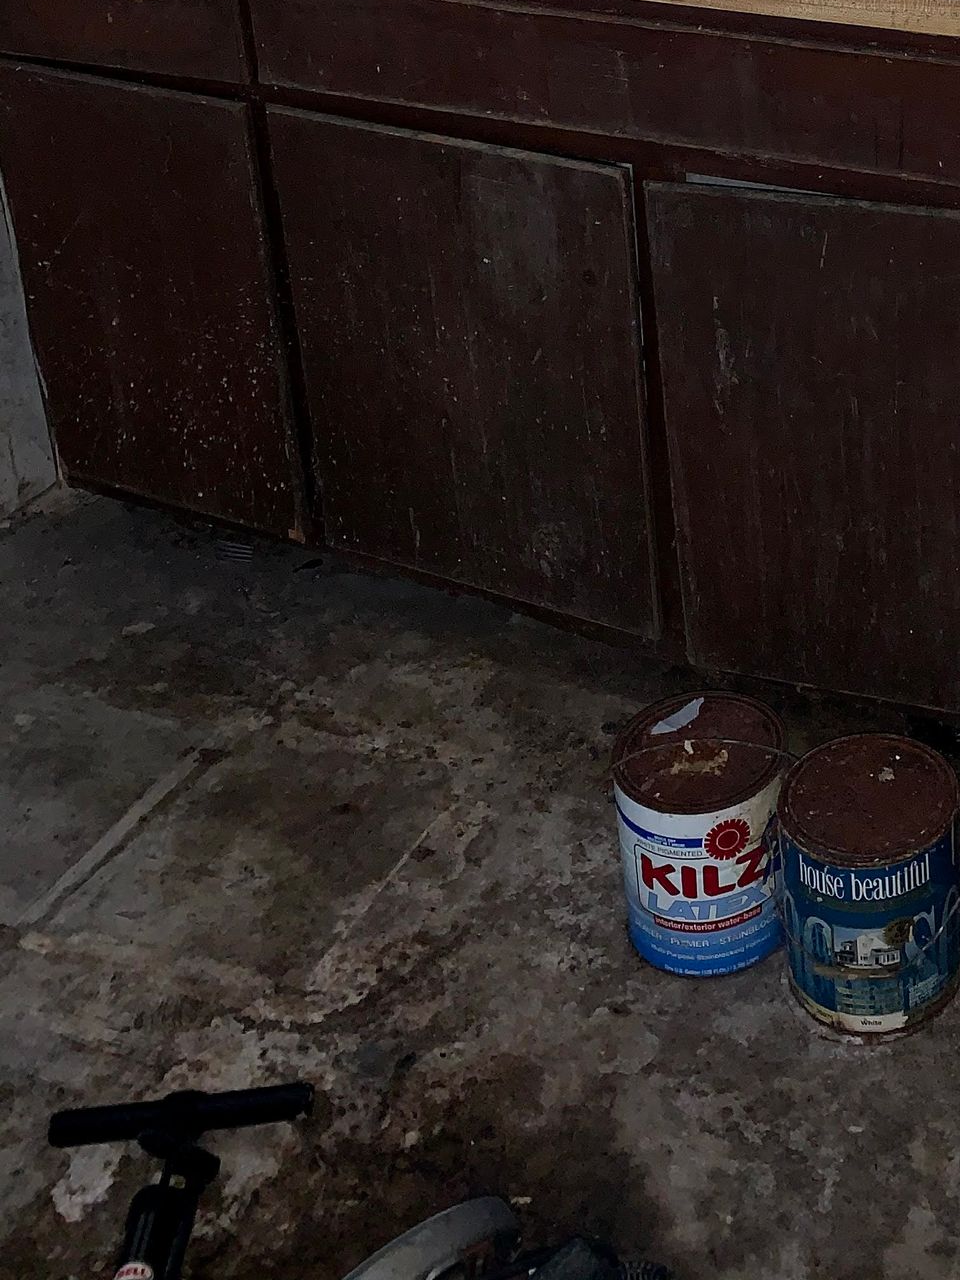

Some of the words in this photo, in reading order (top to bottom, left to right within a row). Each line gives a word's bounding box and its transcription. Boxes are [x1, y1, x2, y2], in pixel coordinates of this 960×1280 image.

[640, 846, 767, 899] KILZ
[798, 853, 846, 900] house
[849, 852, 931, 901] beautiful
[648, 884, 769, 920] LATEX
[655, 915, 716, 932] interior/exterior
